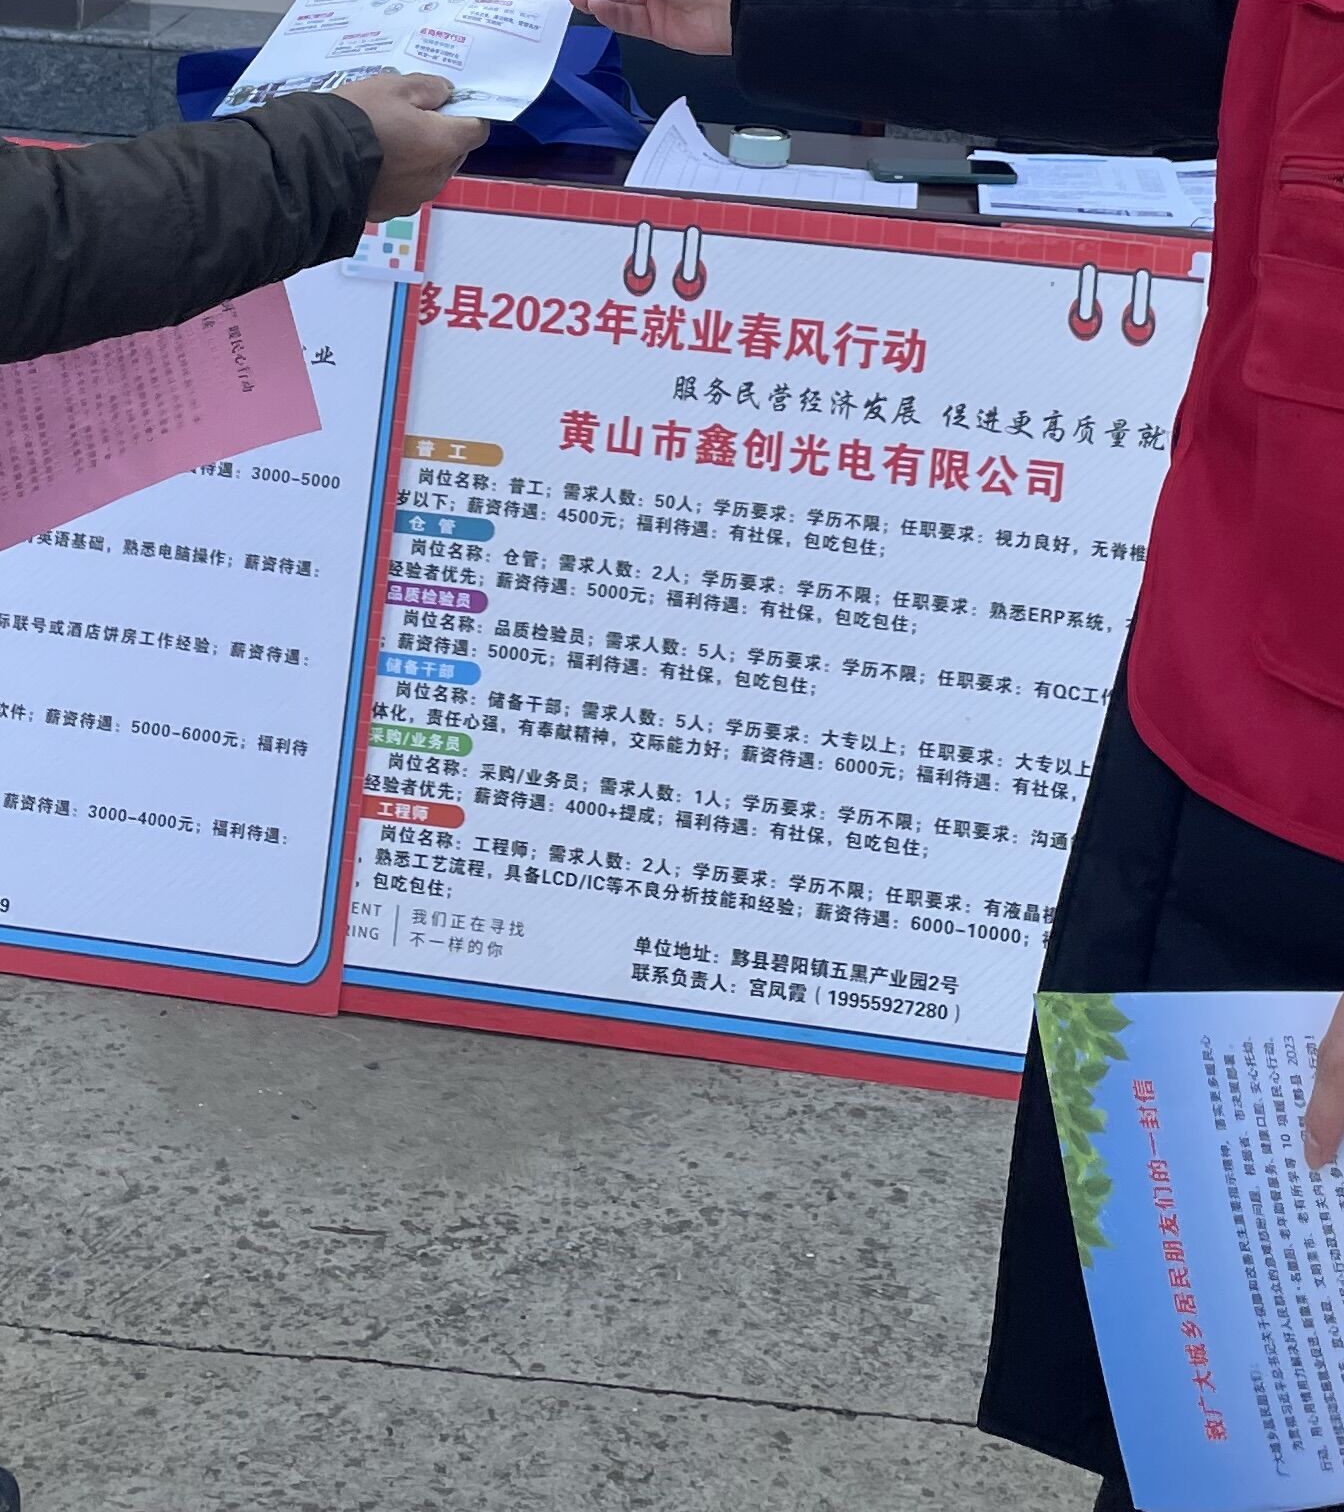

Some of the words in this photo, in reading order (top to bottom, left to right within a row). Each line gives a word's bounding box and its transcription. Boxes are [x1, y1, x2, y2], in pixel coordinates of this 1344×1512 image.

[672, 375, 921, 426] 服务民营经济发展
[559, 408, 1065, 503] 黄山市鑫创光电有限公司
[1132, 1079, 1229, 1442] 致广大城乡居民朋友们的一封信
